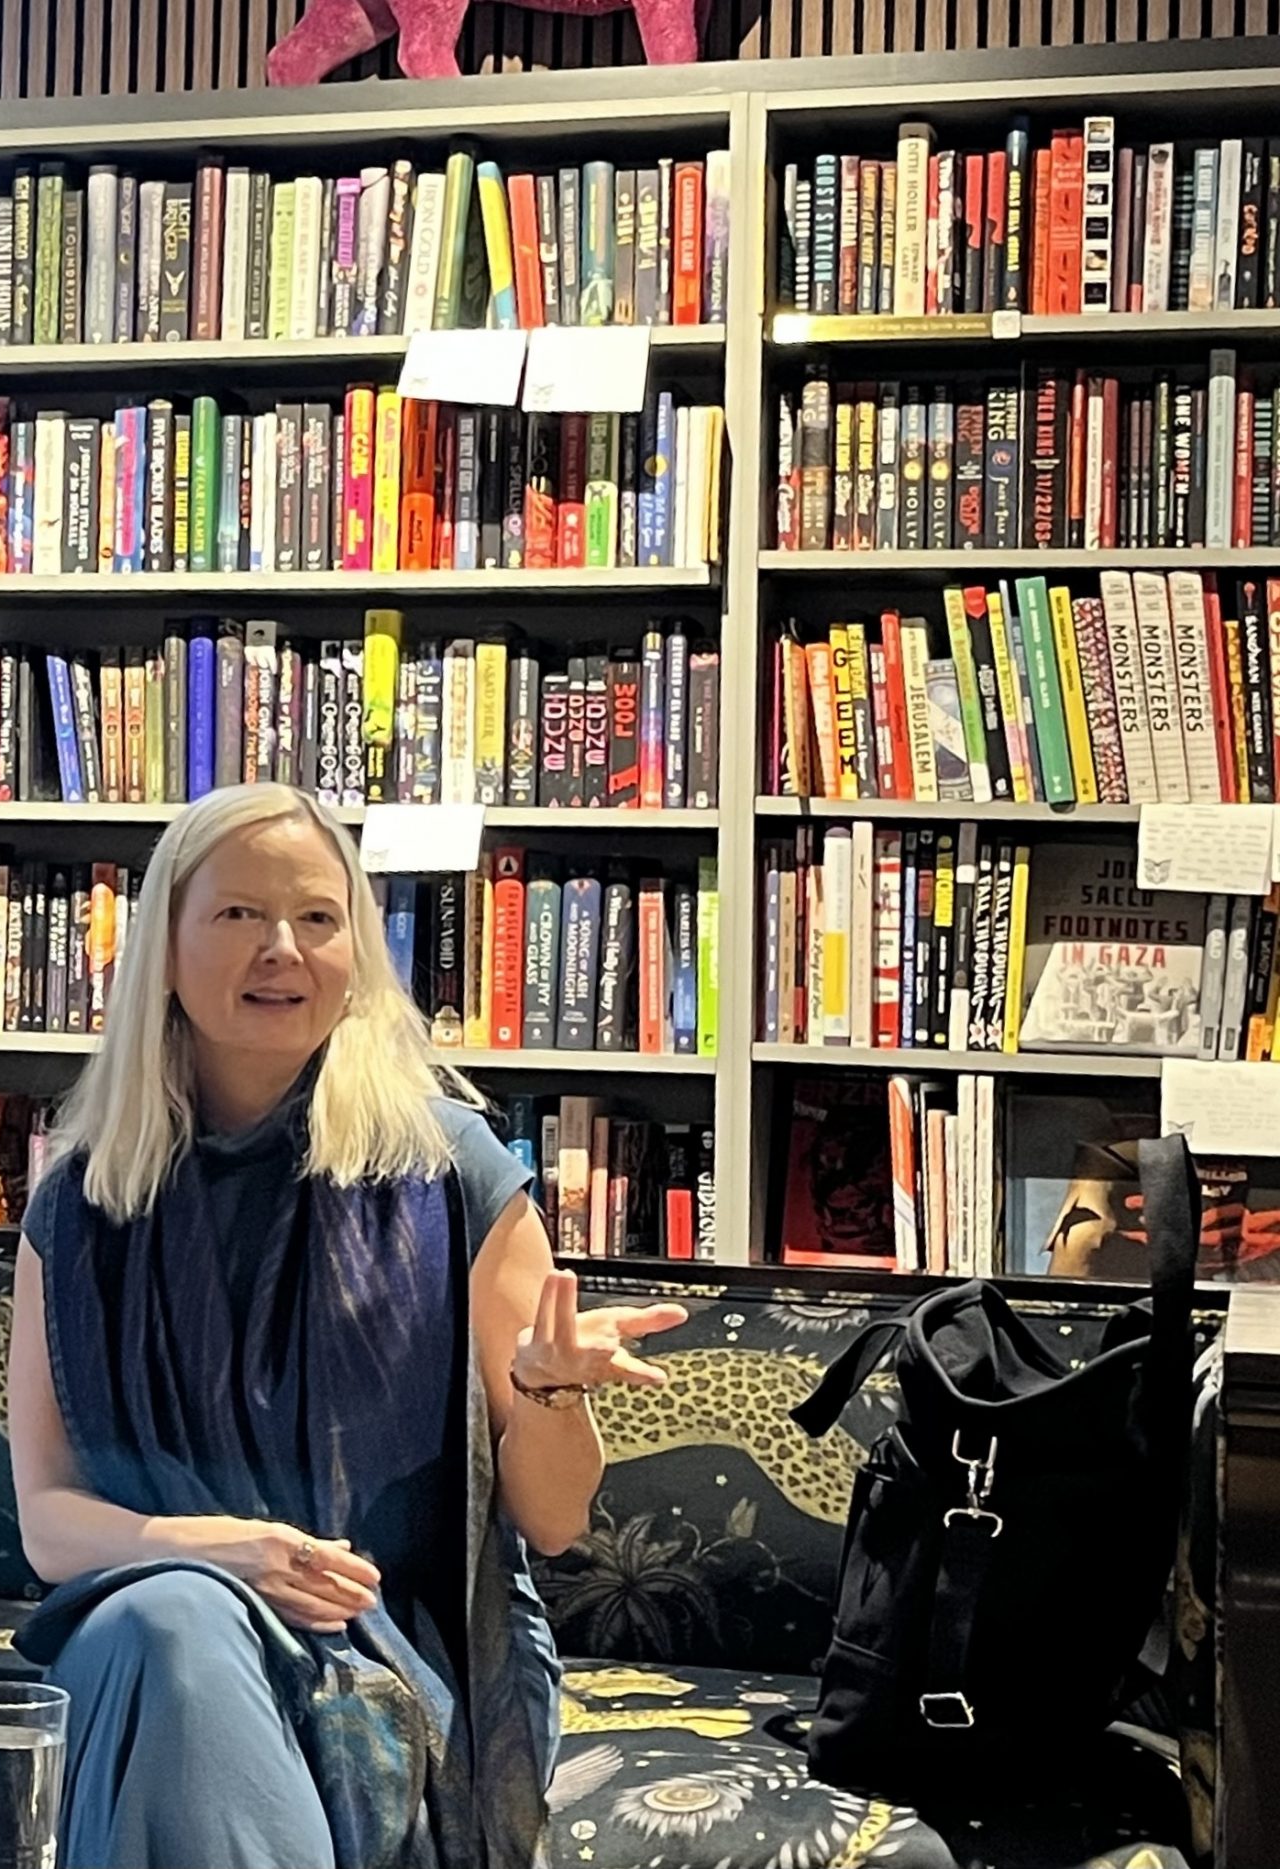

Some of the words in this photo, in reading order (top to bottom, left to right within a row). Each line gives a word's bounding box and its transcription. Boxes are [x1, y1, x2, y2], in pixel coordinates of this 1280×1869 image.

[421, 183, 438, 226] IRON
[682, 177, 696, 235] CASSANDRA
[814, 155, 836, 206] GHOST
[904, 179, 918, 232] HOLLER
[163, 198, 179, 260] BRINGER
[177, 198, 191, 240] LIGHT
[254, 215, 264, 242] BLAKE
[417, 230, 436, 276] GOLD
[681, 238, 695, 271] CLARE
[814, 213, 835, 282] STATION
[63, 226, 76, 330] FOUNDRYSIDE
[710, 259, 723, 311] HEAVEN
[153, 418, 167, 446] FIVE
[988, 390, 1005, 441] KING
[1036, 425, 1054, 455] KING
[79, 446, 91, 505] JONATHAN
[150, 449, 166, 503] BROKEN
[1174, 433, 1190, 495] WOMEN
[508, 465, 522, 537] SPELLSHOP
[905, 486, 918, 540] HOLLY
[932, 486, 945, 540] HOLLY
[1034, 473, 1056, 541] 11/22/63
[78, 507, 89, 560] STRANGE
[150, 505, 165, 554] BLADES
[1244, 616, 1262, 684] SANDMAN
[1111, 624, 1139, 733] MONSTERS
[1144, 624, 1170, 733] MONSTERS
[1178, 624, 1206, 733] MONSTERS
[257, 706, 270, 766] GWYNNE
[909, 684, 930, 774] JERUSALEM
[440, 885, 455, 922] SUN
[976, 876, 992, 918] FALL
[992, 877, 1010, 918] FALL
[1080, 884, 1154, 907] SACCO
[440, 938, 454, 969] VOID
[540, 912, 552, 965] CROWN
[578, 919, 590, 954] SONG
[1043, 914, 1189, 942] FOOTNOTES
[526, 945, 538, 984] GLASS
[564, 921, 578, 1007] MOONLIGHT
[972, 919, 991, 1002] THROUGH
[991, 919, 1010, 1002] THROUGH
[1062, 944, 1085, 963] IN
[1098, 944, 1167, 969] GAZA
[538, 982, 550, 1006] IVY
[577, 973, 589, 998] ASH
